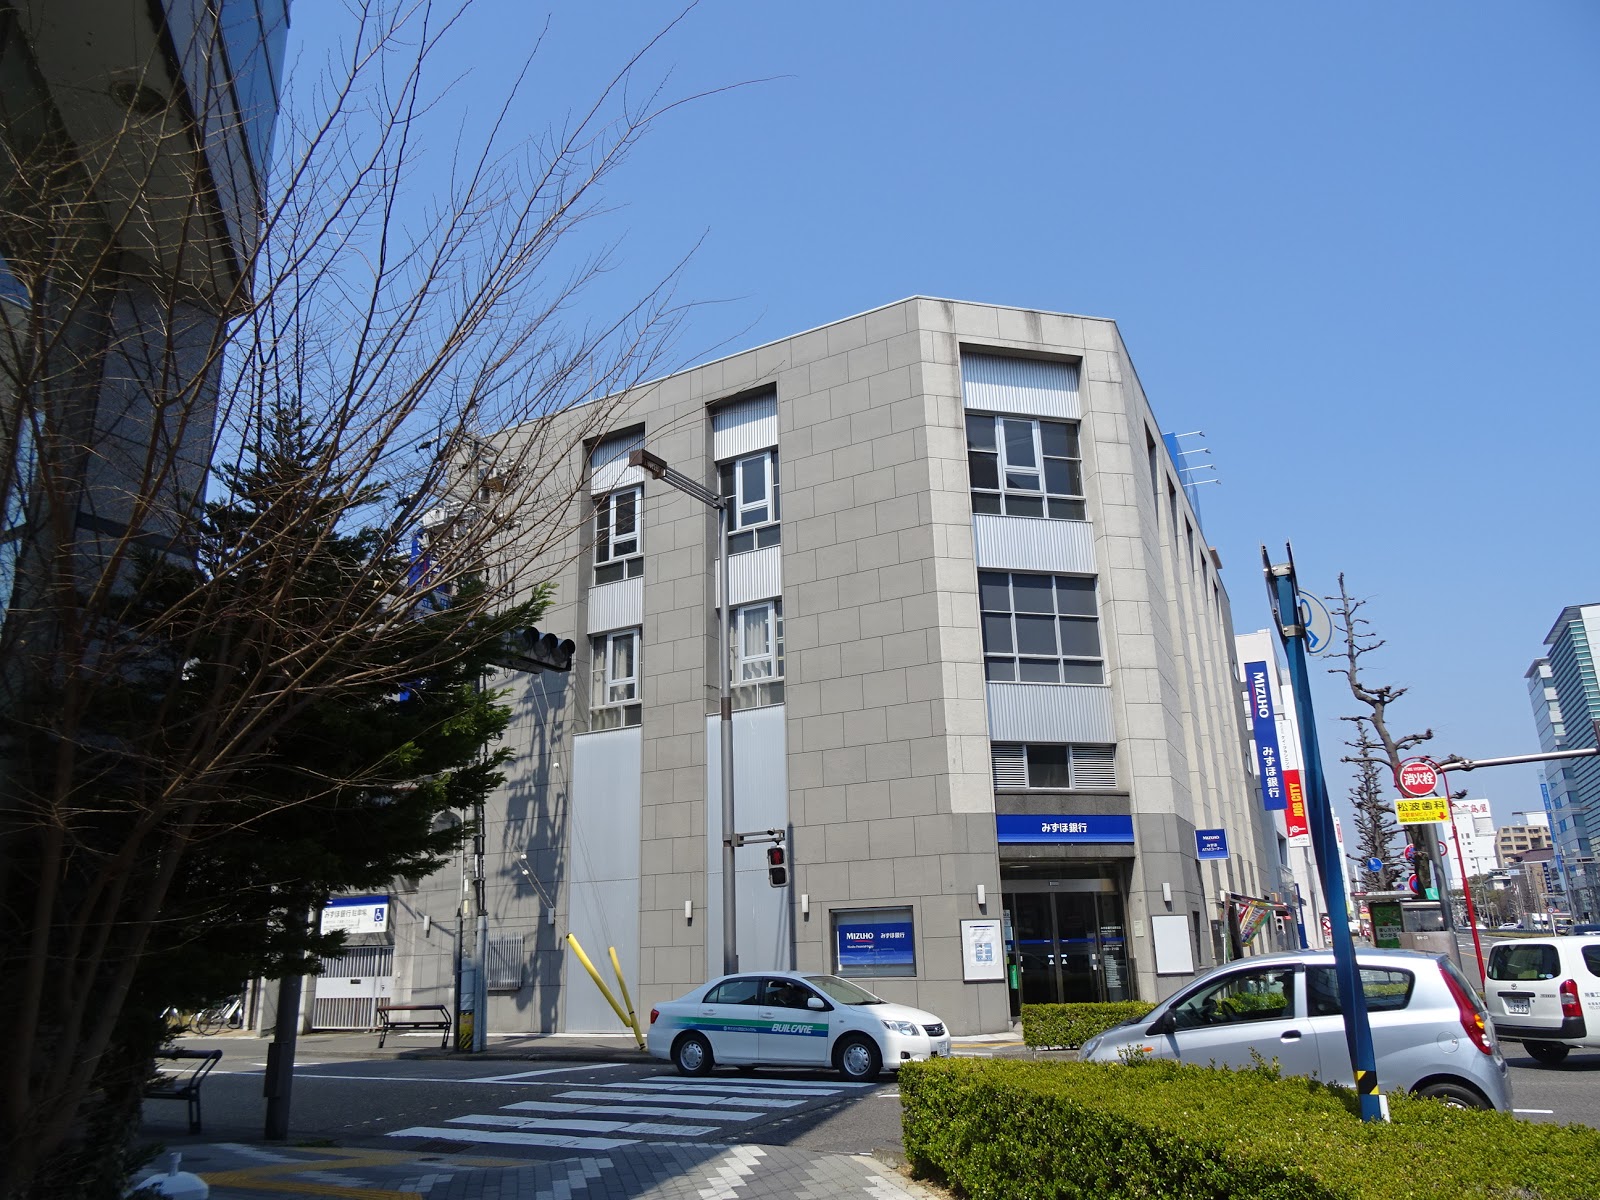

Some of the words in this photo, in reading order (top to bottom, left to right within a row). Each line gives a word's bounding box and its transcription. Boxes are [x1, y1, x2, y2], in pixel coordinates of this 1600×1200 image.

[1253, 672, 1269, 718] MIZUHO
[1262, 746, 1280, 798] みずほ銀行
[1403, 773, 1435, 785] 消火栓
[1289, 783, 1302, 801] CITY
[1292, 802, 1304, 817] JOB
[1397, 801, 1445, 811] 松波歯科
[1041, 822, 1088, 833] みずほ銀行
[846, 932, 874, 940] MIZUHO
[880, 931, 905, 939] みずほ銀行
